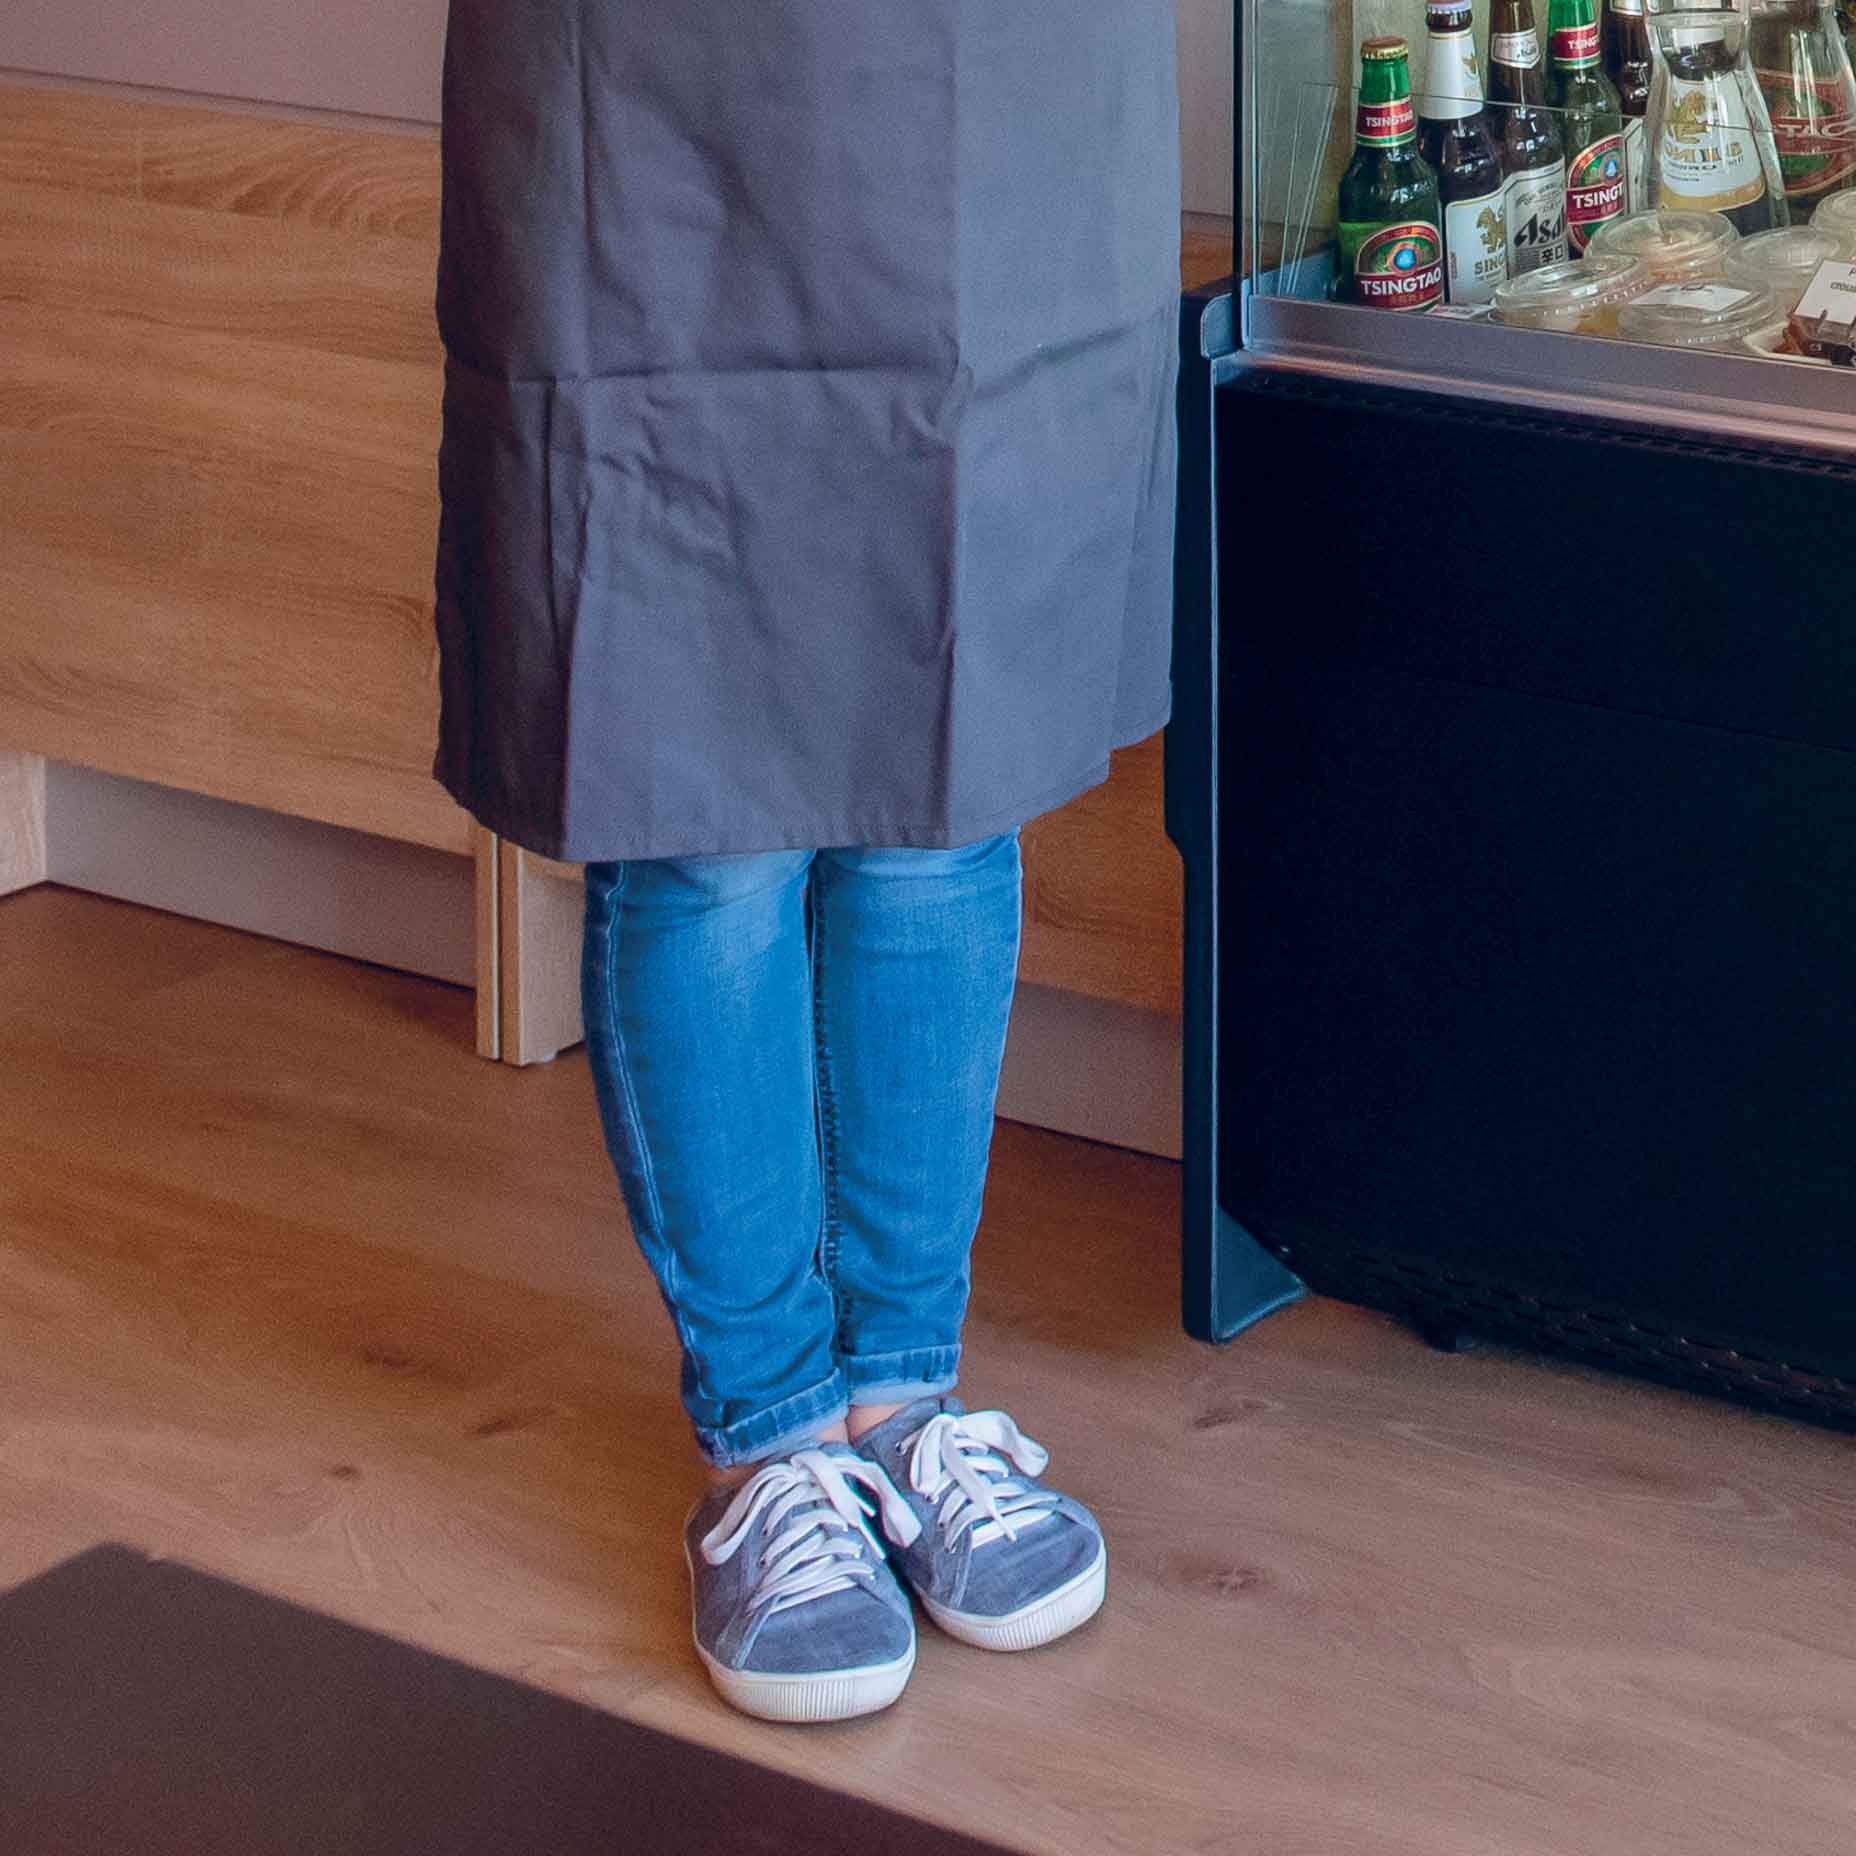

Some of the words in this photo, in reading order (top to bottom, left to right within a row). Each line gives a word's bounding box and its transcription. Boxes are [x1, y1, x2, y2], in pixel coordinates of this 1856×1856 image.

[1572, 181, 1624, 210] TSINGT
[1513, 206, 1566, 248] Asa
[1360, 266, 1441, 295] TSINGTAO
